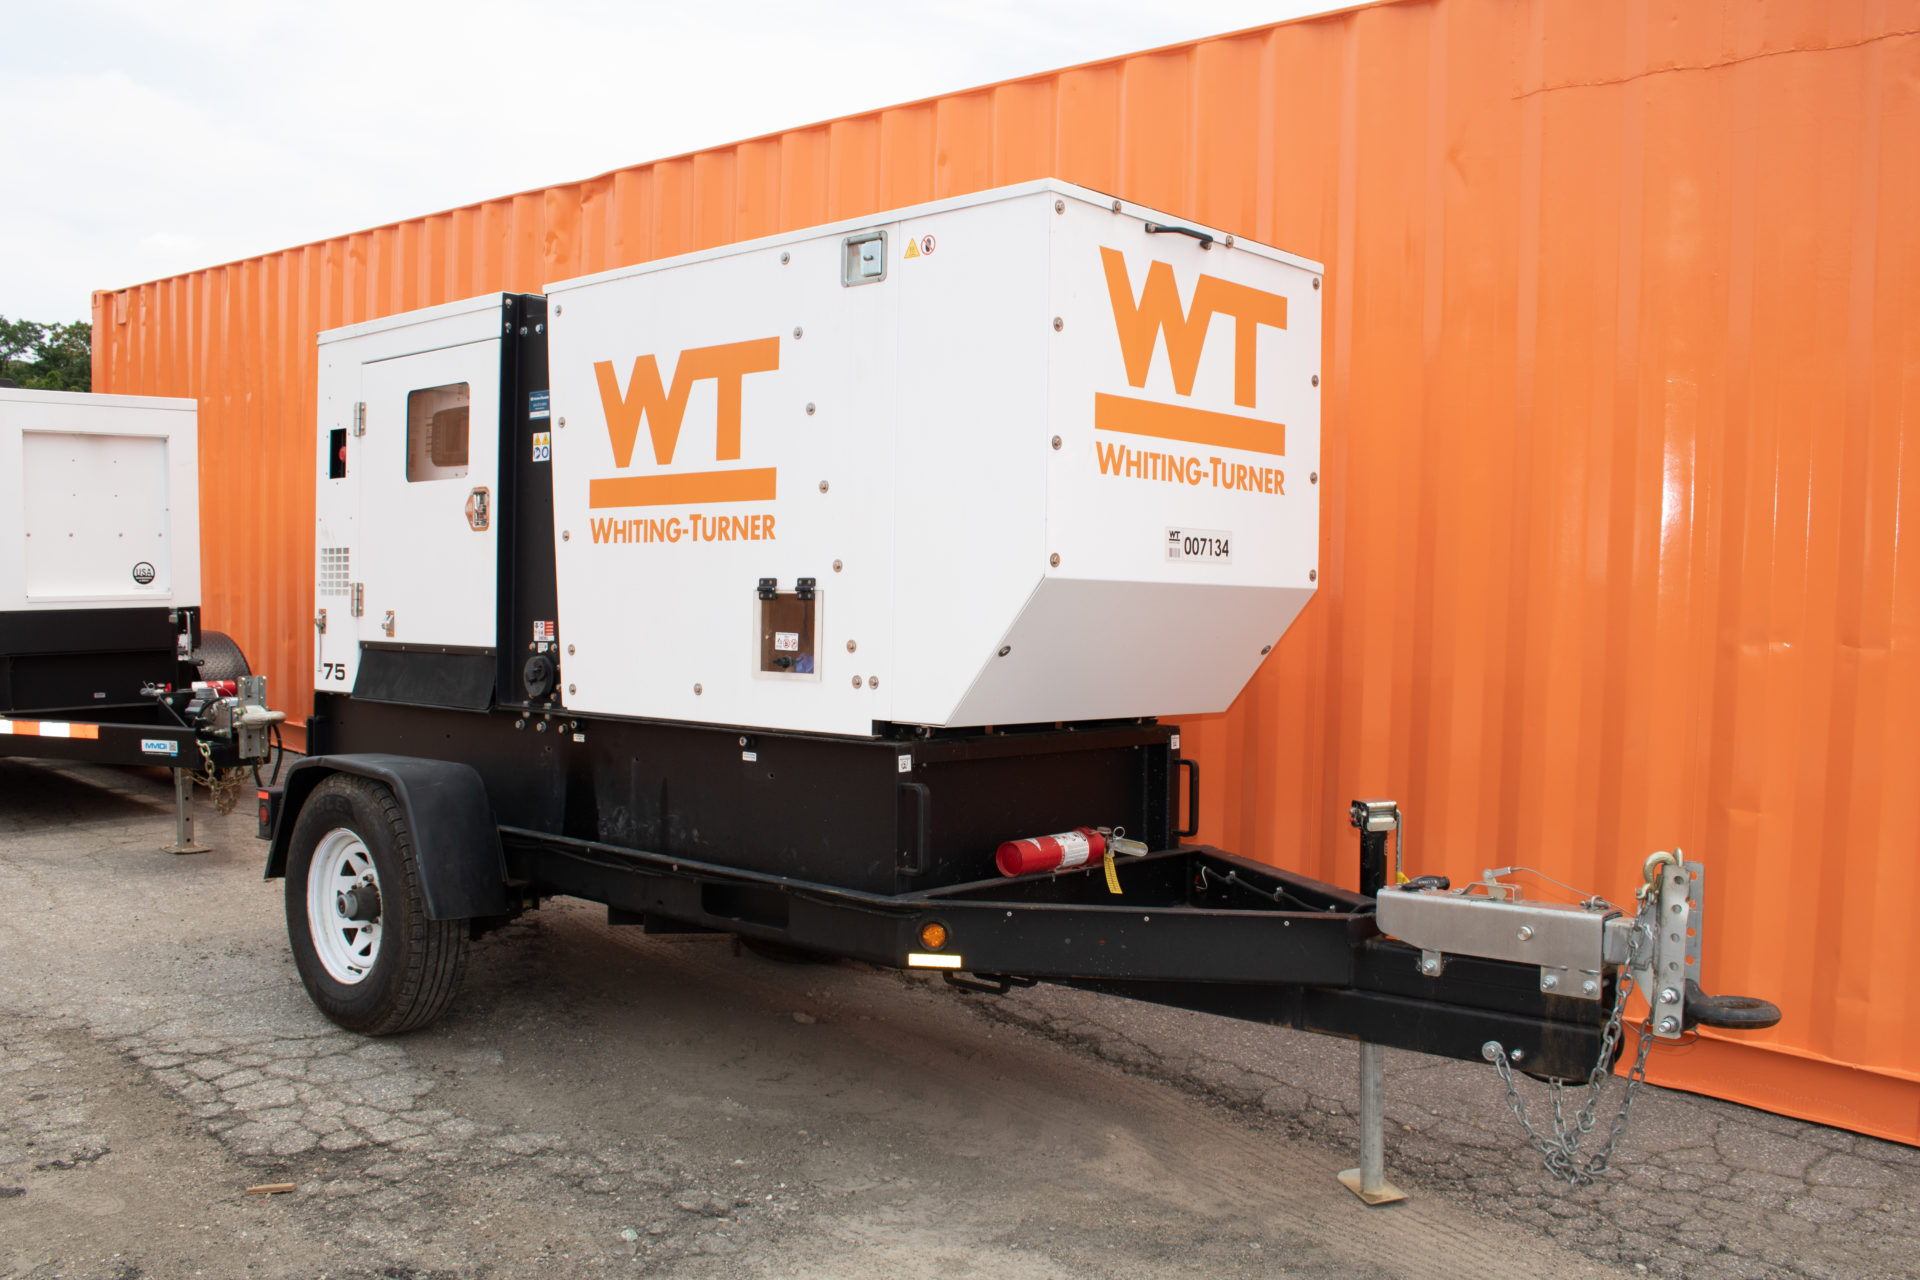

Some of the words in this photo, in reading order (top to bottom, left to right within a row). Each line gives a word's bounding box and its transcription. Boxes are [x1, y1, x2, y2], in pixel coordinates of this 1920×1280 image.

[1100, 246, 1287, 408] WT
[594, 337, 780, 468] WT
[1096, 442, 1285, 495] WHITING-TURNER
[591, 514, 776, 544] WHITING-TURNER
[1184, 536, 1229, 557] 007134
[135, 568, 152, 576] USA
[323, 662, 346, 681] 75
